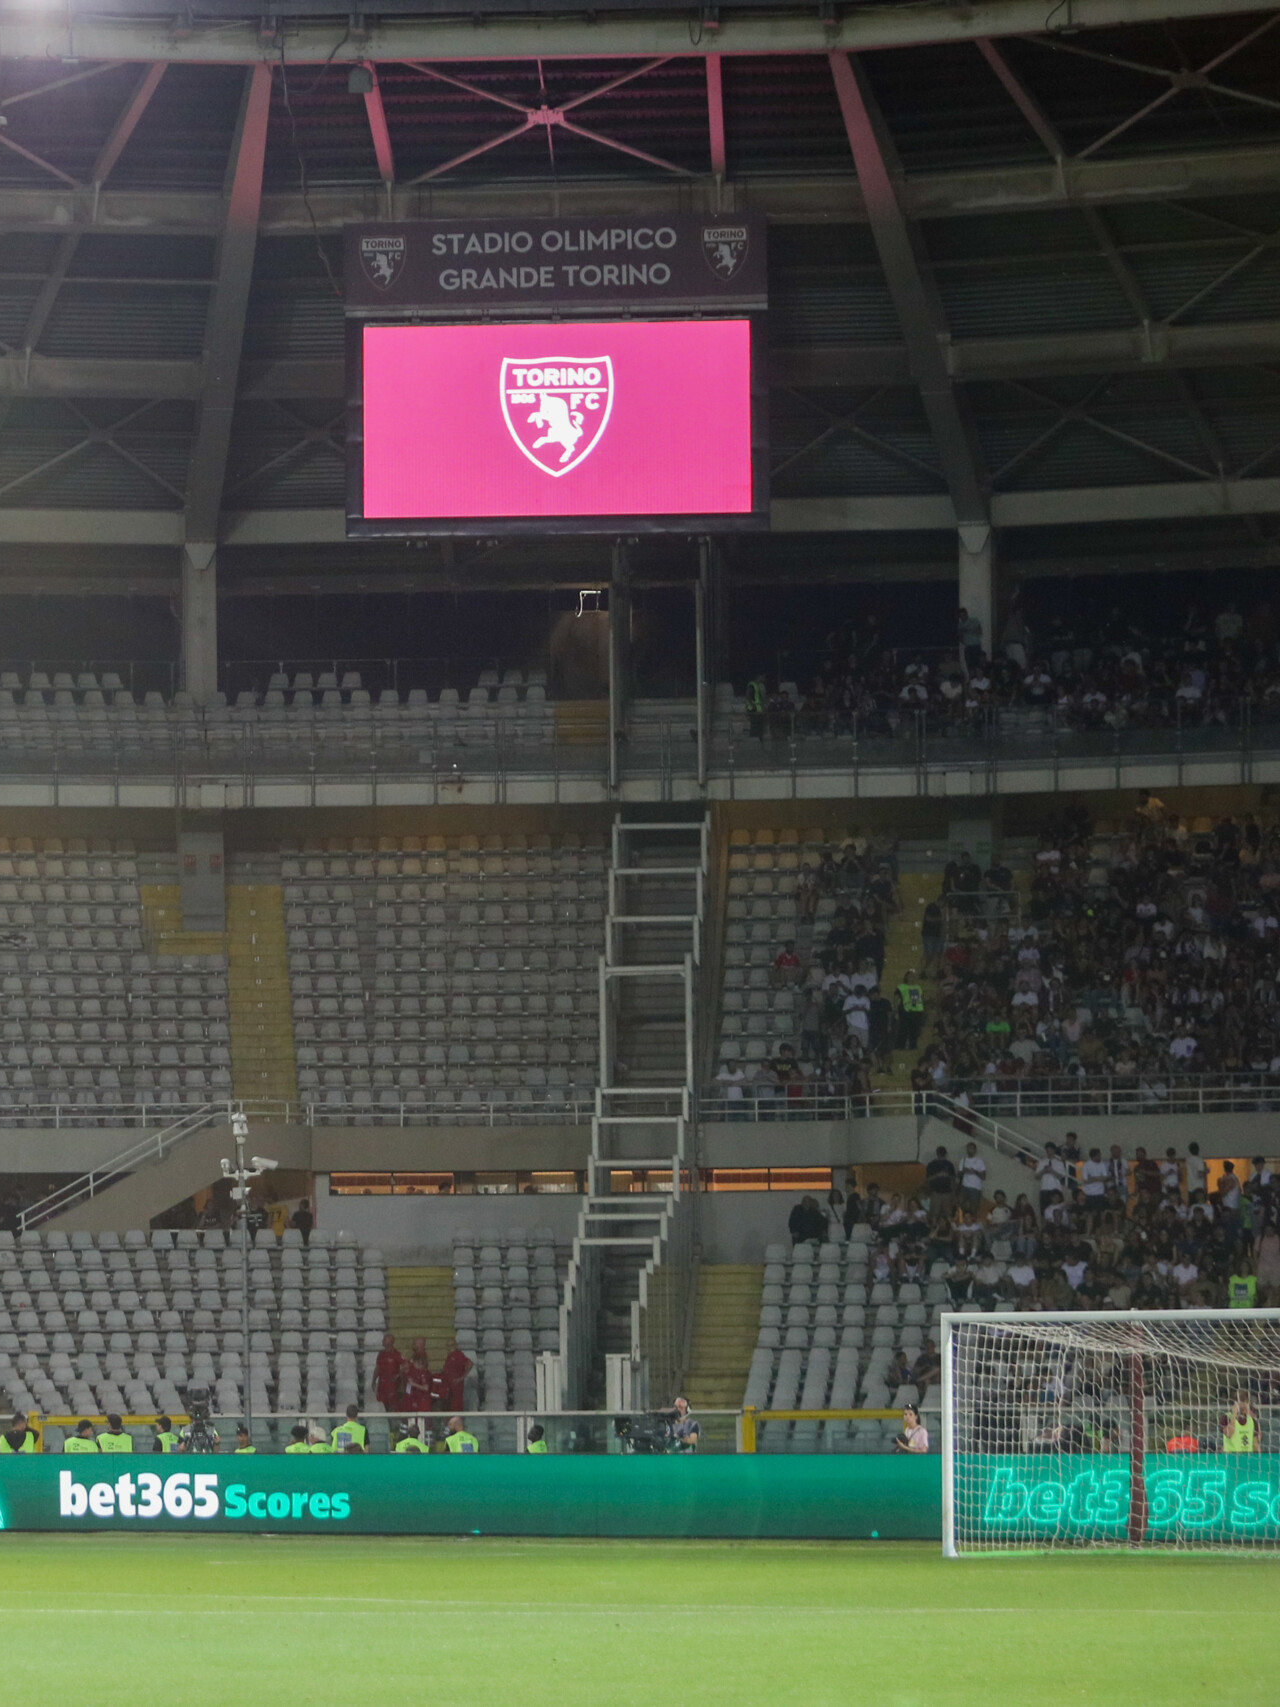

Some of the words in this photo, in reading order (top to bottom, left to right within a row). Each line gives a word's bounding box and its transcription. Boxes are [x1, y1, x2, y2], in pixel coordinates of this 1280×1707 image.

[363, 240, 402, 249] TORINO
[431, 231, 533, 255] STADIO
[540, 227, 677, 251] OLIMPICO
[706, 230, 745, 240] TORINO
[438, 266, 555, 290] GRANDE
[561, 263, 671, 287] TORINO
[511, 366, 602, 387] TORINO
[569, 392, 601, 411] FC
[59, 1470, 220, 1518] bet365
[225, 1484, 350, 1518] Scores
[984, 1467, 1226, 1525] bet365
